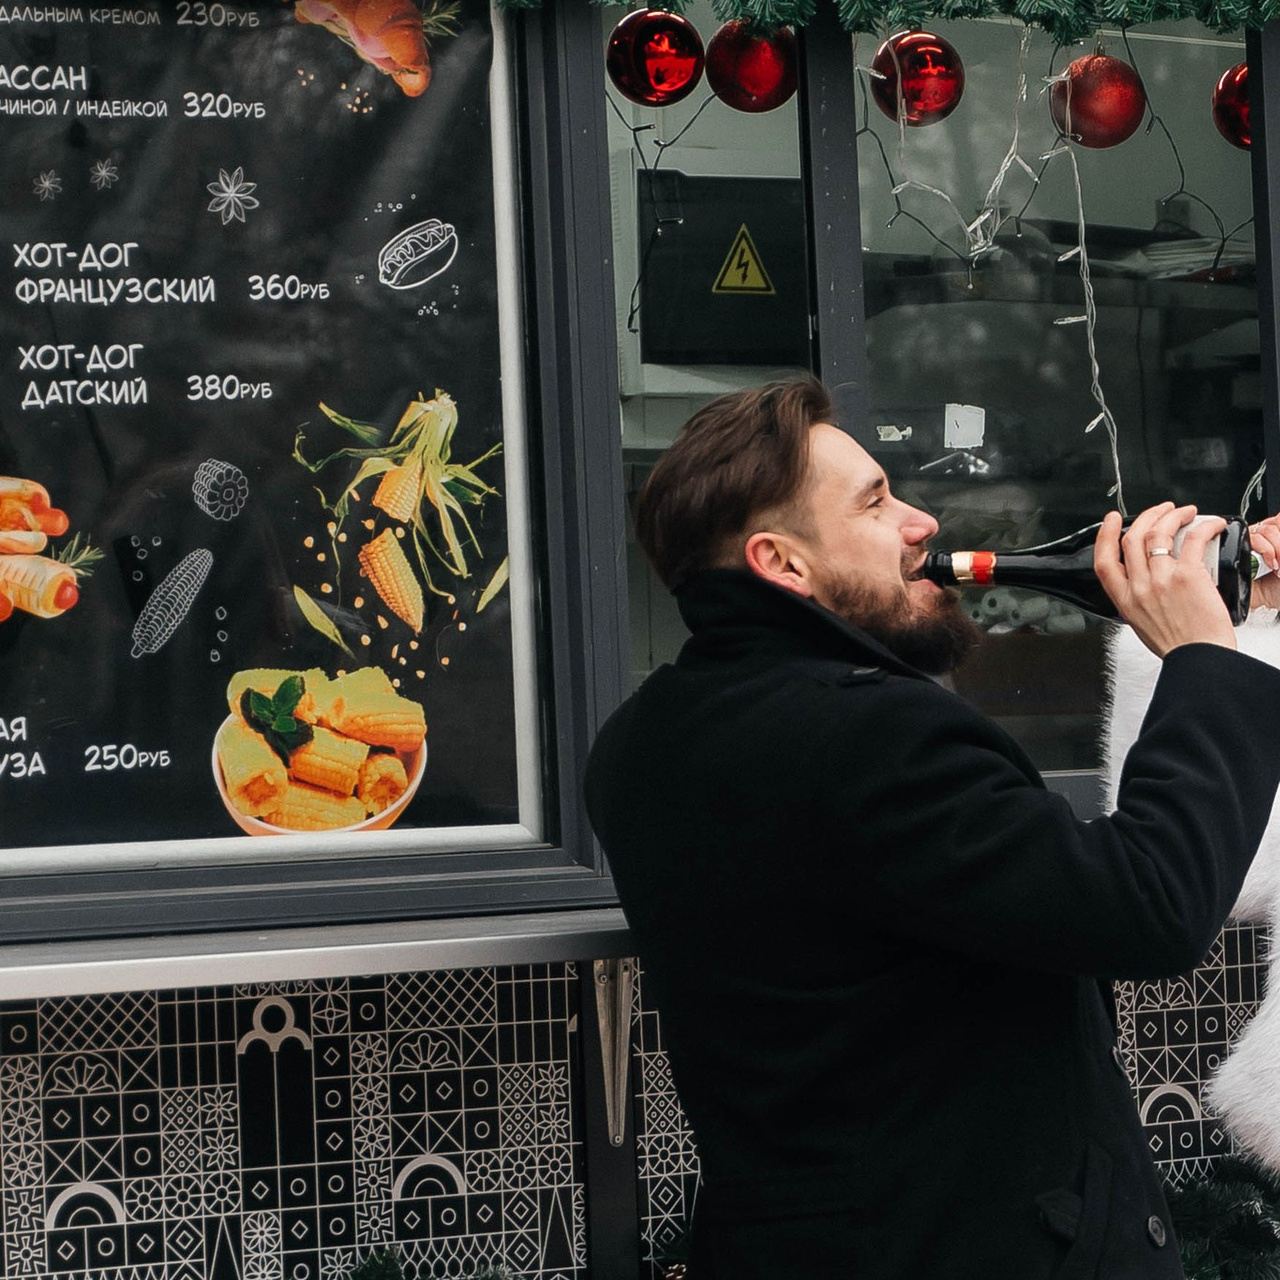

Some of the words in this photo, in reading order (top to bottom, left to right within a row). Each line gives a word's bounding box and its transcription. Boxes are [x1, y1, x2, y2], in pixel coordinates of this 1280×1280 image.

[89, 8, 161, 25] КРЕМОМ
[175, 1, 260, 28] 230РУБ
[76, 99, 168, 119] ИНДЕЙКОЙ
[183, 91, 266, 118] 320РУБ
[13, 242, 139, 272] ХОТ-ДОГ
[15, 276, 216, 307] ФРАНЦУЗСКИЙ
[248, 274, 330, 301] 360РУБ
[18, 343, 144, 373] ХОТ-ДОГ
[21, 376, 148, 410] ДАТСКИЙ
[186, 374, 273, 401] 380РУБ
[84, 743, 171, 772] 250РУБ
